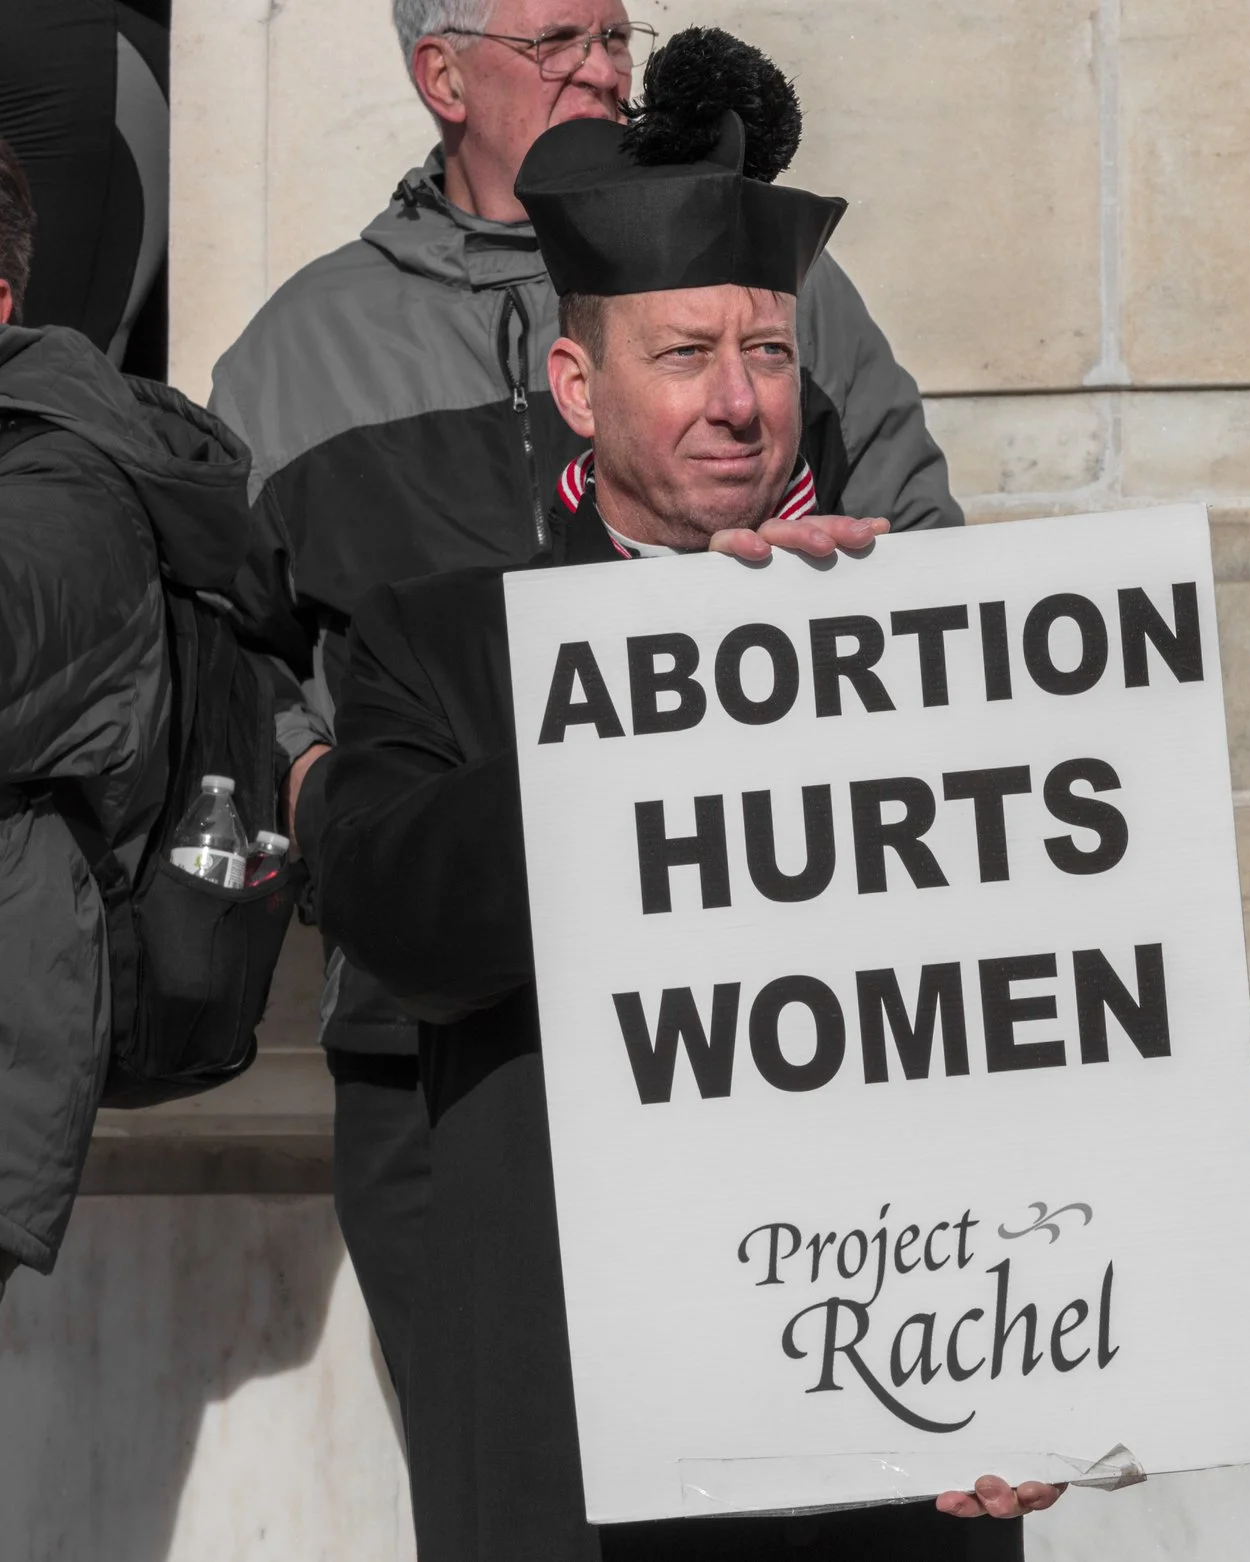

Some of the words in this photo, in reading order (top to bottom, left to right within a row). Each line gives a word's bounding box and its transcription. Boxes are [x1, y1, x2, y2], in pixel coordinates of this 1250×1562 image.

[537, 581, 1206, 745] ABORTION
[634, 757, 1129, 915] HURTS
[612, 942, 1172, 1105] WOMEN
[737, 1203, 980, 1308] Project
[781, 1258, 1120, 1434] Rachel
